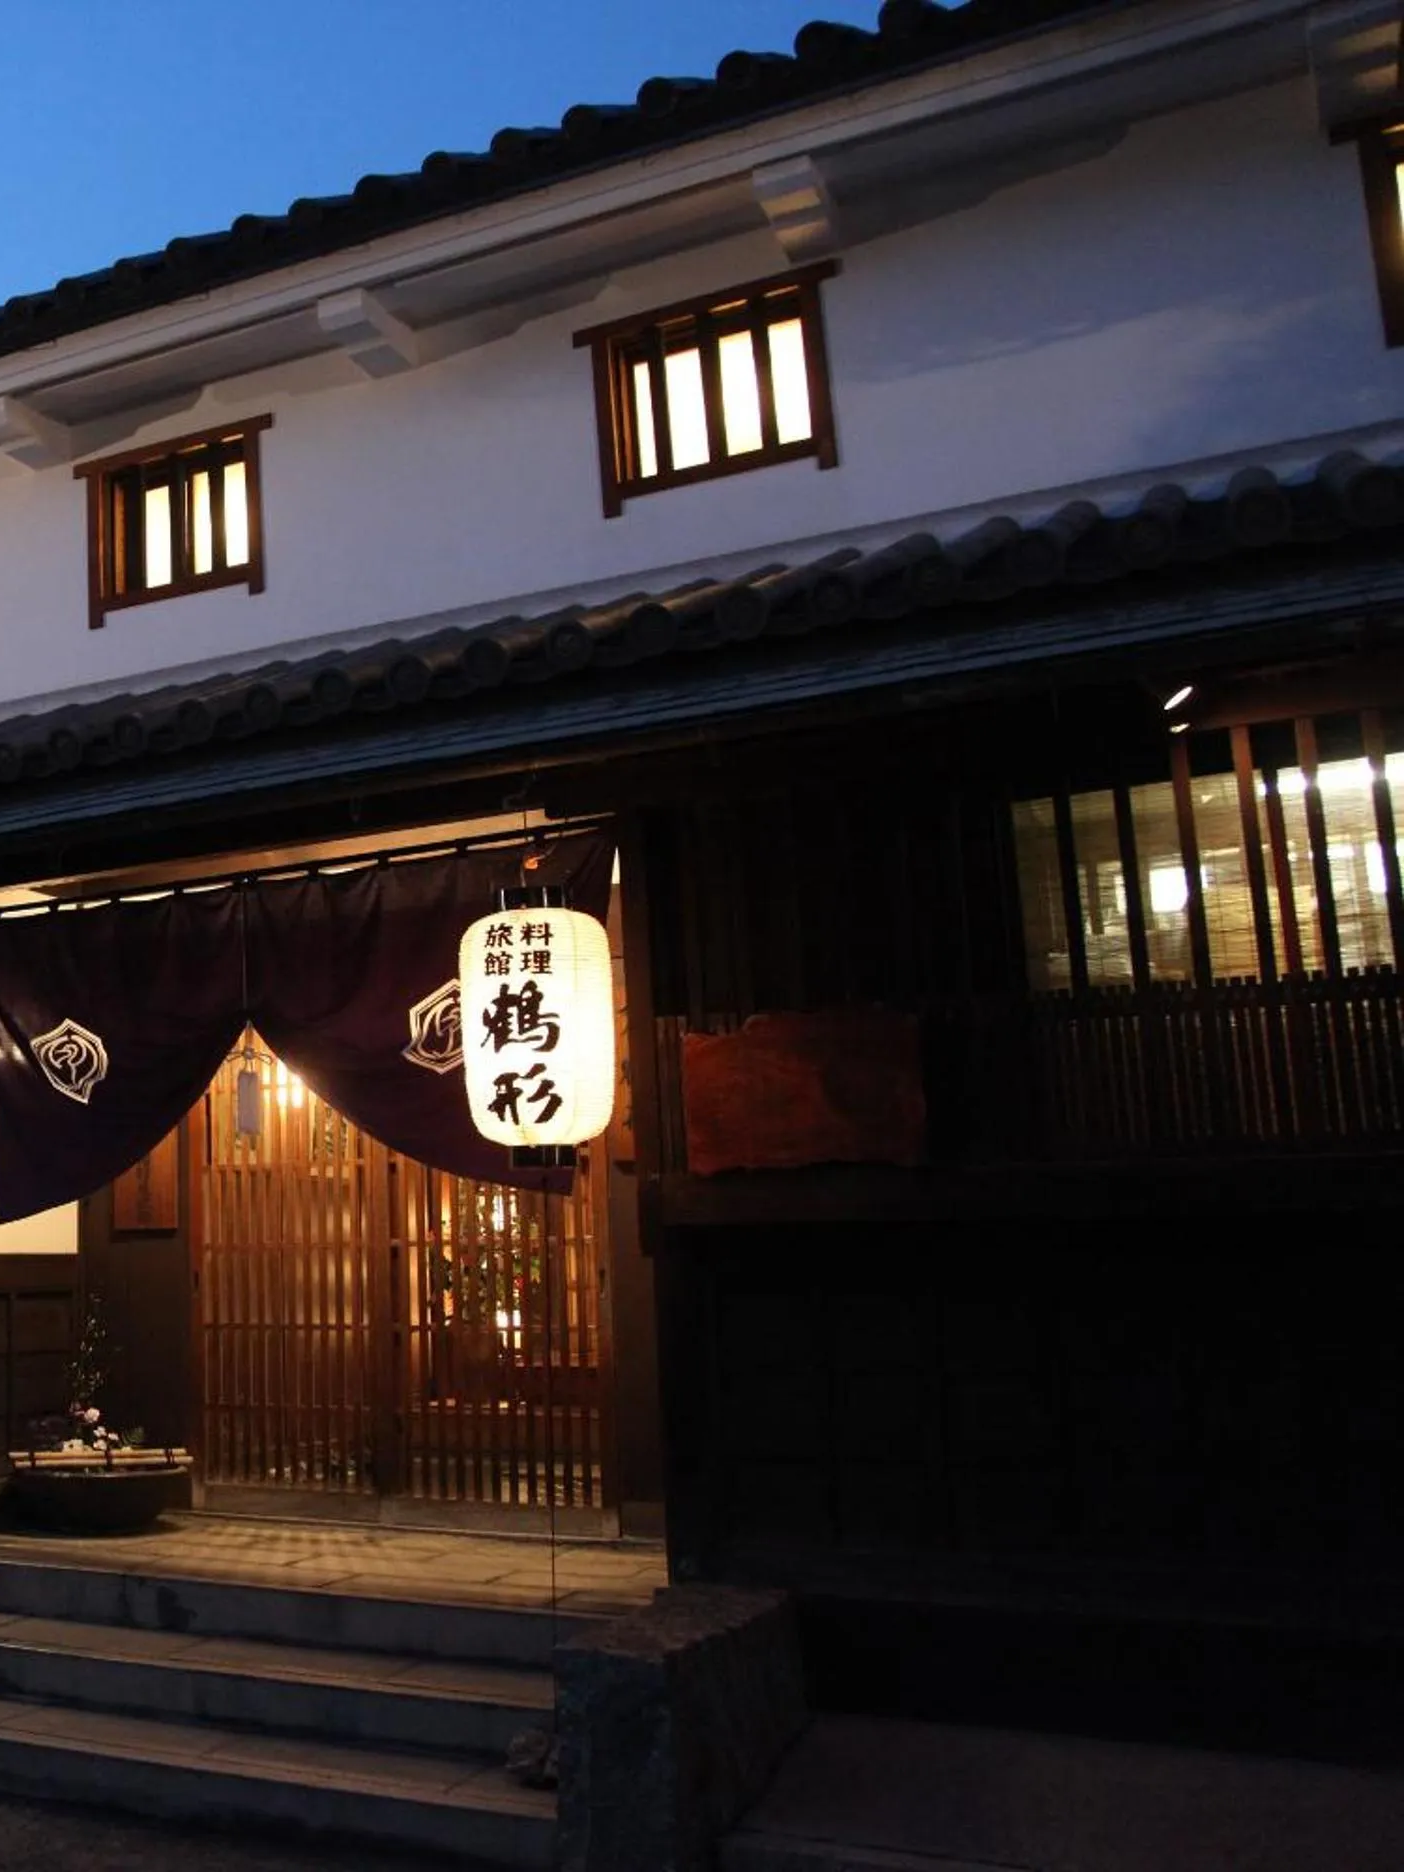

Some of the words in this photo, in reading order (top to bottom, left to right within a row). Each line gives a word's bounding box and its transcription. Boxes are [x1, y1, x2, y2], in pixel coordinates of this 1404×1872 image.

[483, 922, 514, 977] 旅館
[519, 921, 553, 975] 料理
[480, 979, 564, 1126] 鶴形
